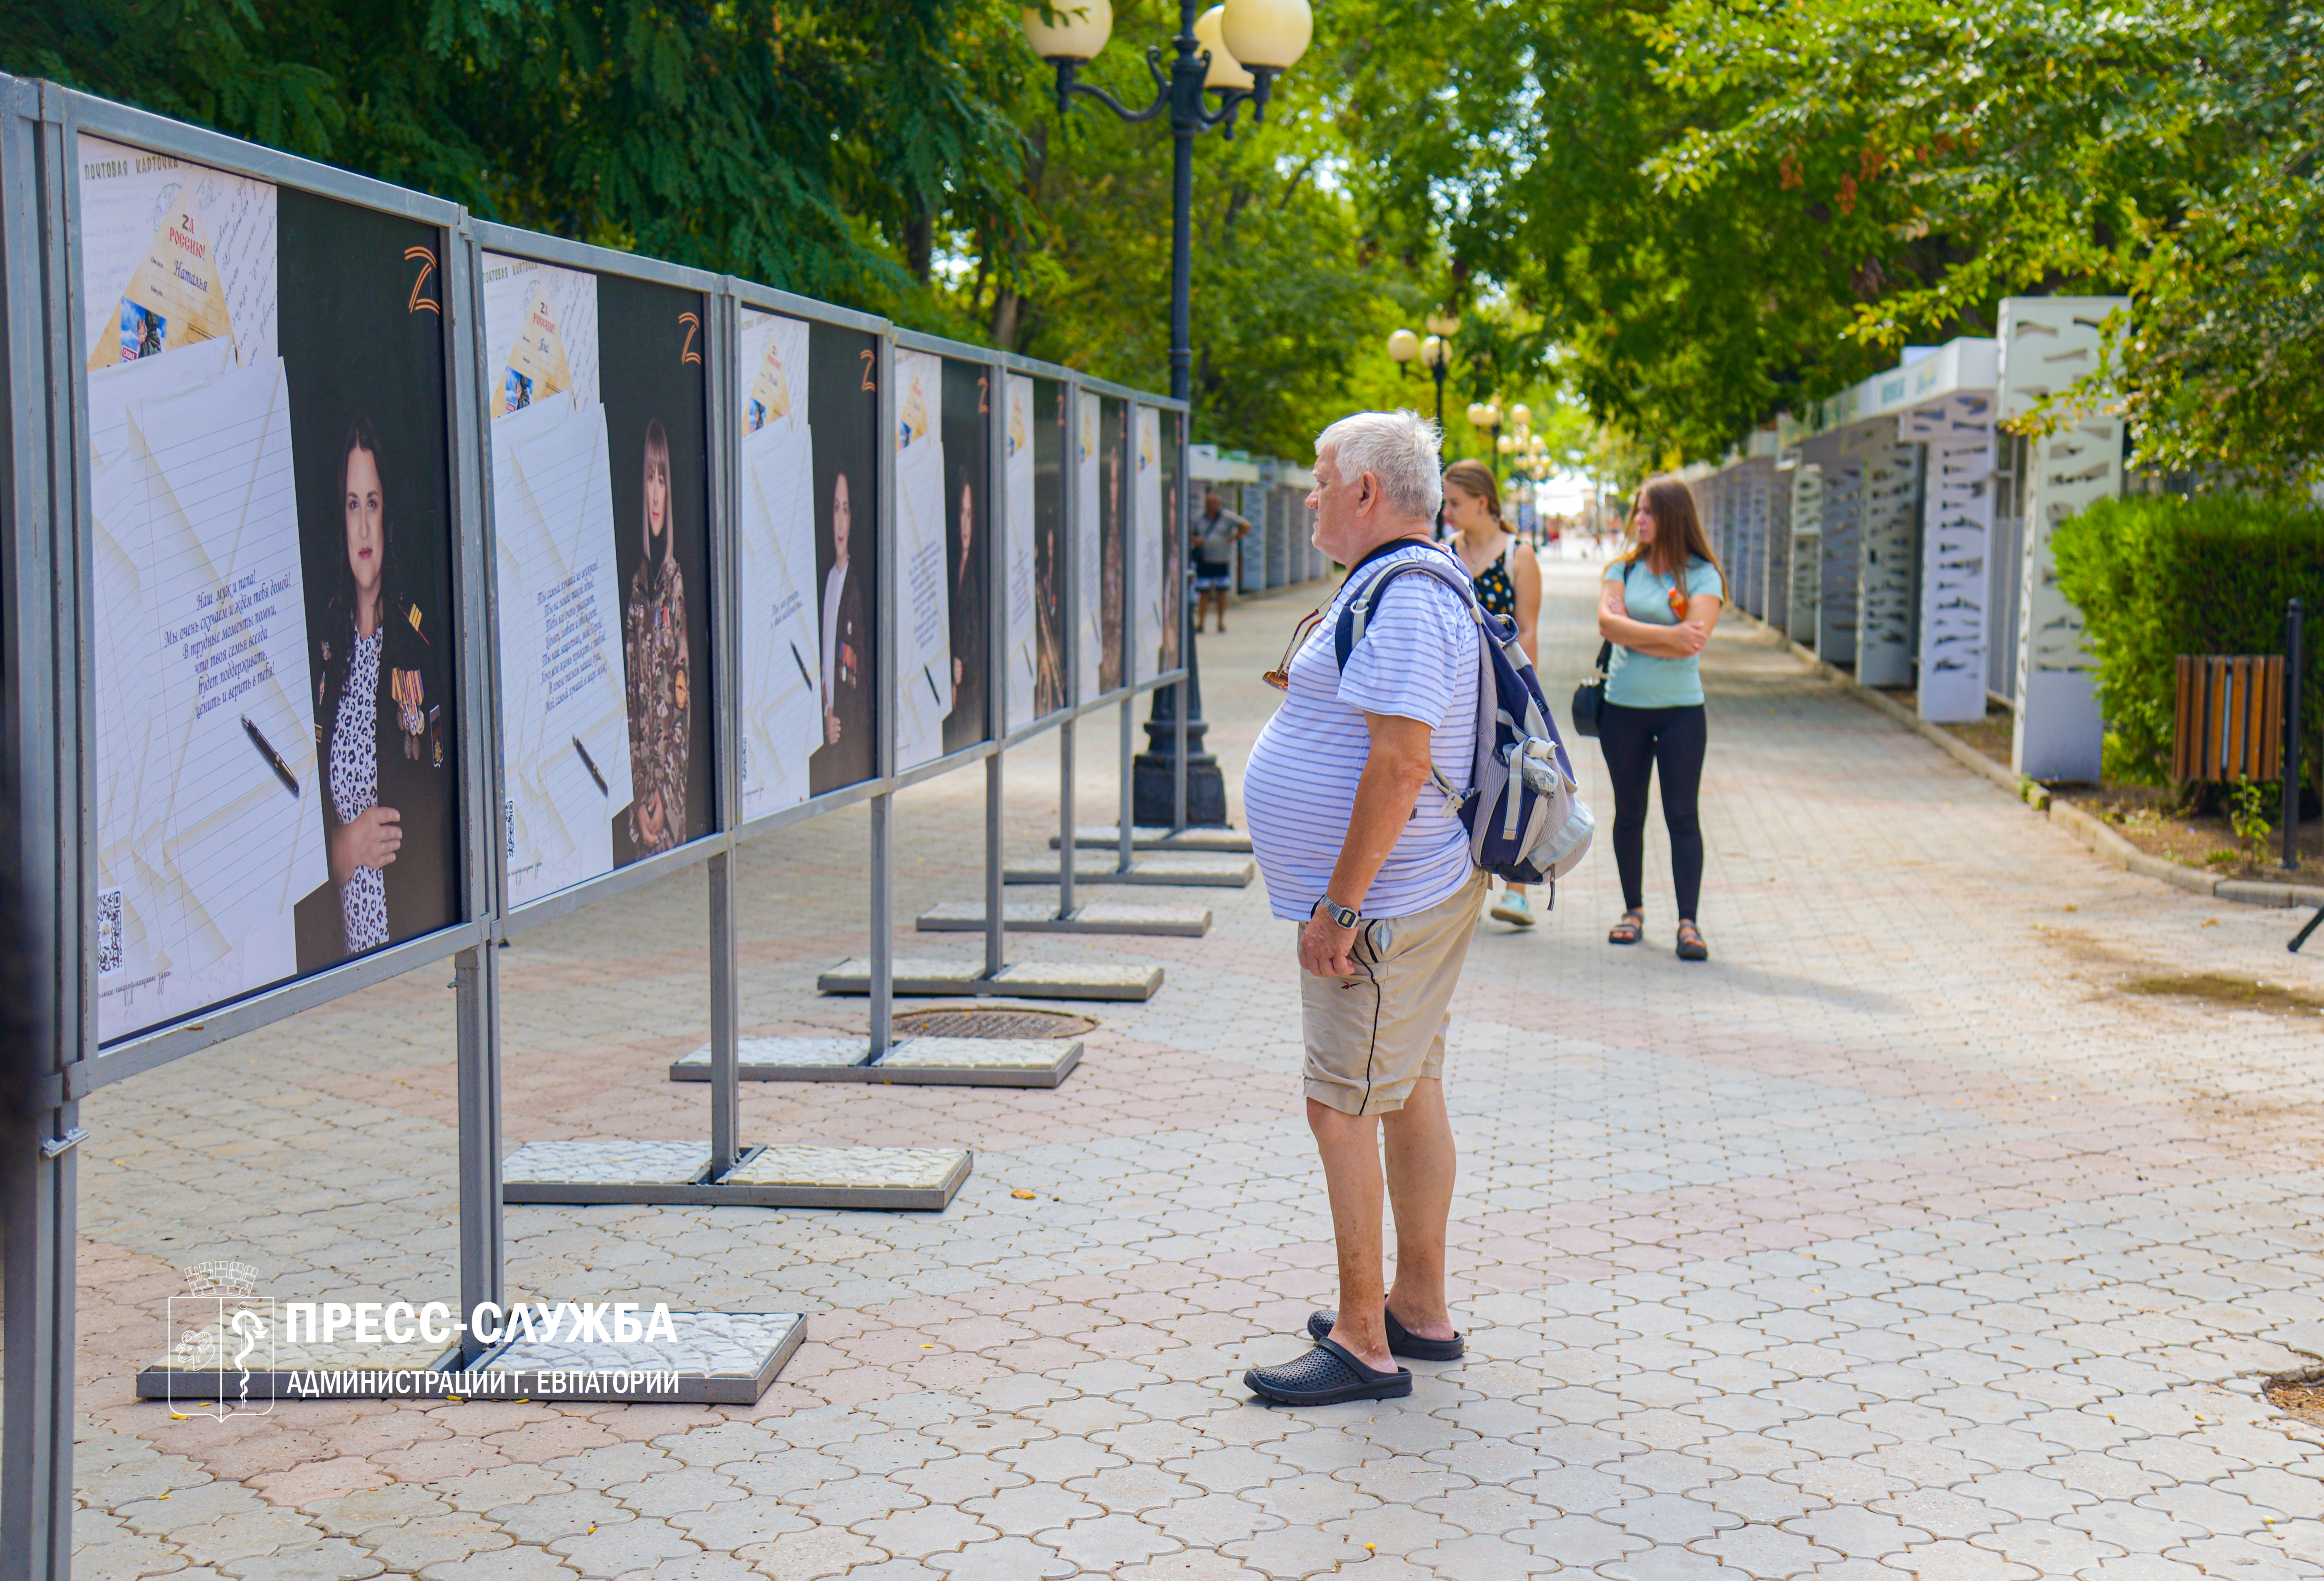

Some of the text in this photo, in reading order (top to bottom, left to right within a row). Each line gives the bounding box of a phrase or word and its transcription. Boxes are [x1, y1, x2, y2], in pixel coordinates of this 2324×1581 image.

[85, 156, 178, 180] ПОЧТОВАЯ КАРТОЧКА
[169, 227, 205, 260] РОССИЮ!
[151, 285, 163, 296] Откуда
[173, 260, 208, 292] Наталья
[534, 312, 555, 335] РОССИЮ!
[197, 569, 256, 610] Наш муж и папа!
[538, 590, 546, 605] Ты
[547, 582, 560, 599] самый
[561, 573, 576, 593] лучший
[164, 573, 291, 648] Мы очень скучаем и ждём тебя домой!
[544, 602, 553, 617] Ты
[554, 601, 559, 611] на
[560, 594, 570, 608] земле
[546, 614, 558, 632] Тебя
[566, 607, 576, 619] очень
[183, 605, 277, 659] В трудные моменты помни,
[561, 621, 574, 638] любят
[195, 625, 268, 674] что твоя семья всегда
[542, 653, 551, 667] Ты
[199, 651, 267, 698] будет поддерживать,
[541, 670, 551, 685] Хочу
[560, 657, 572, 672] жизнь
[196, 661, 275, 721] ценить и верить в тебя!
[546, 698, 554, 714] Мой
[556, 688, 569, 706] самый
[570, 677, 583, 699] лучший
[98, 971, 171, 1006] ольше информации здесь
